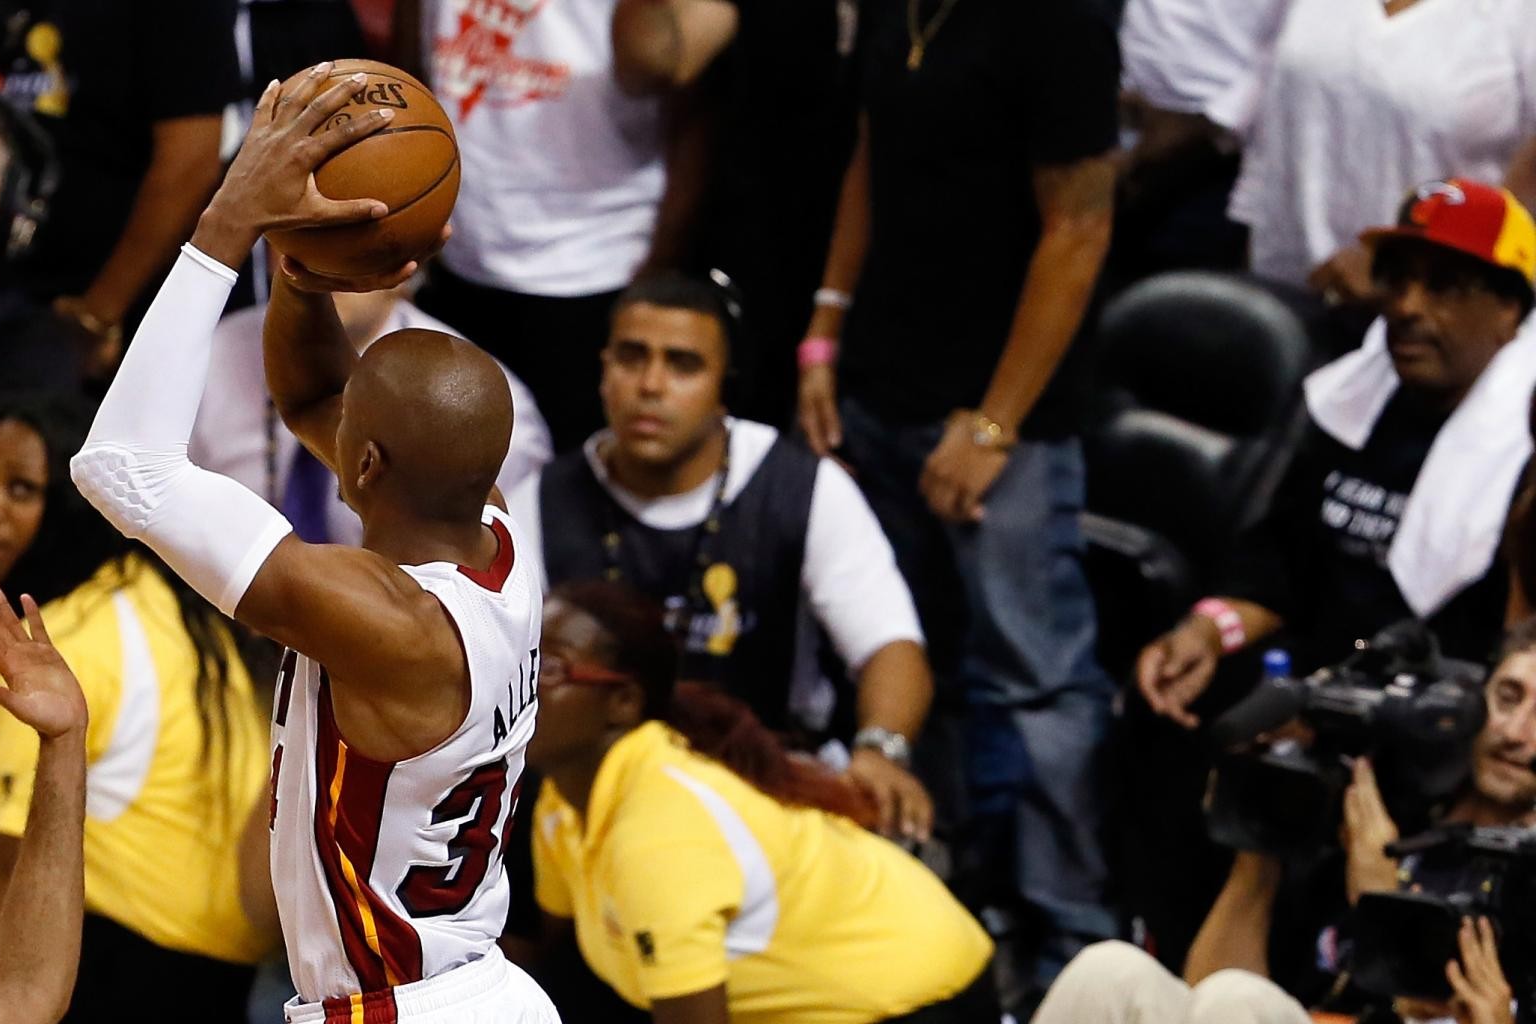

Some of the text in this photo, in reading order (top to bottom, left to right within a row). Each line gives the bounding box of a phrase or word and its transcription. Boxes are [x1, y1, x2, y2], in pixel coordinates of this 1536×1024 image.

[350, 83, 408, 109] SPA
[491, 647, 538, 751] ALLE
[395, 754, 522, 919] 3
